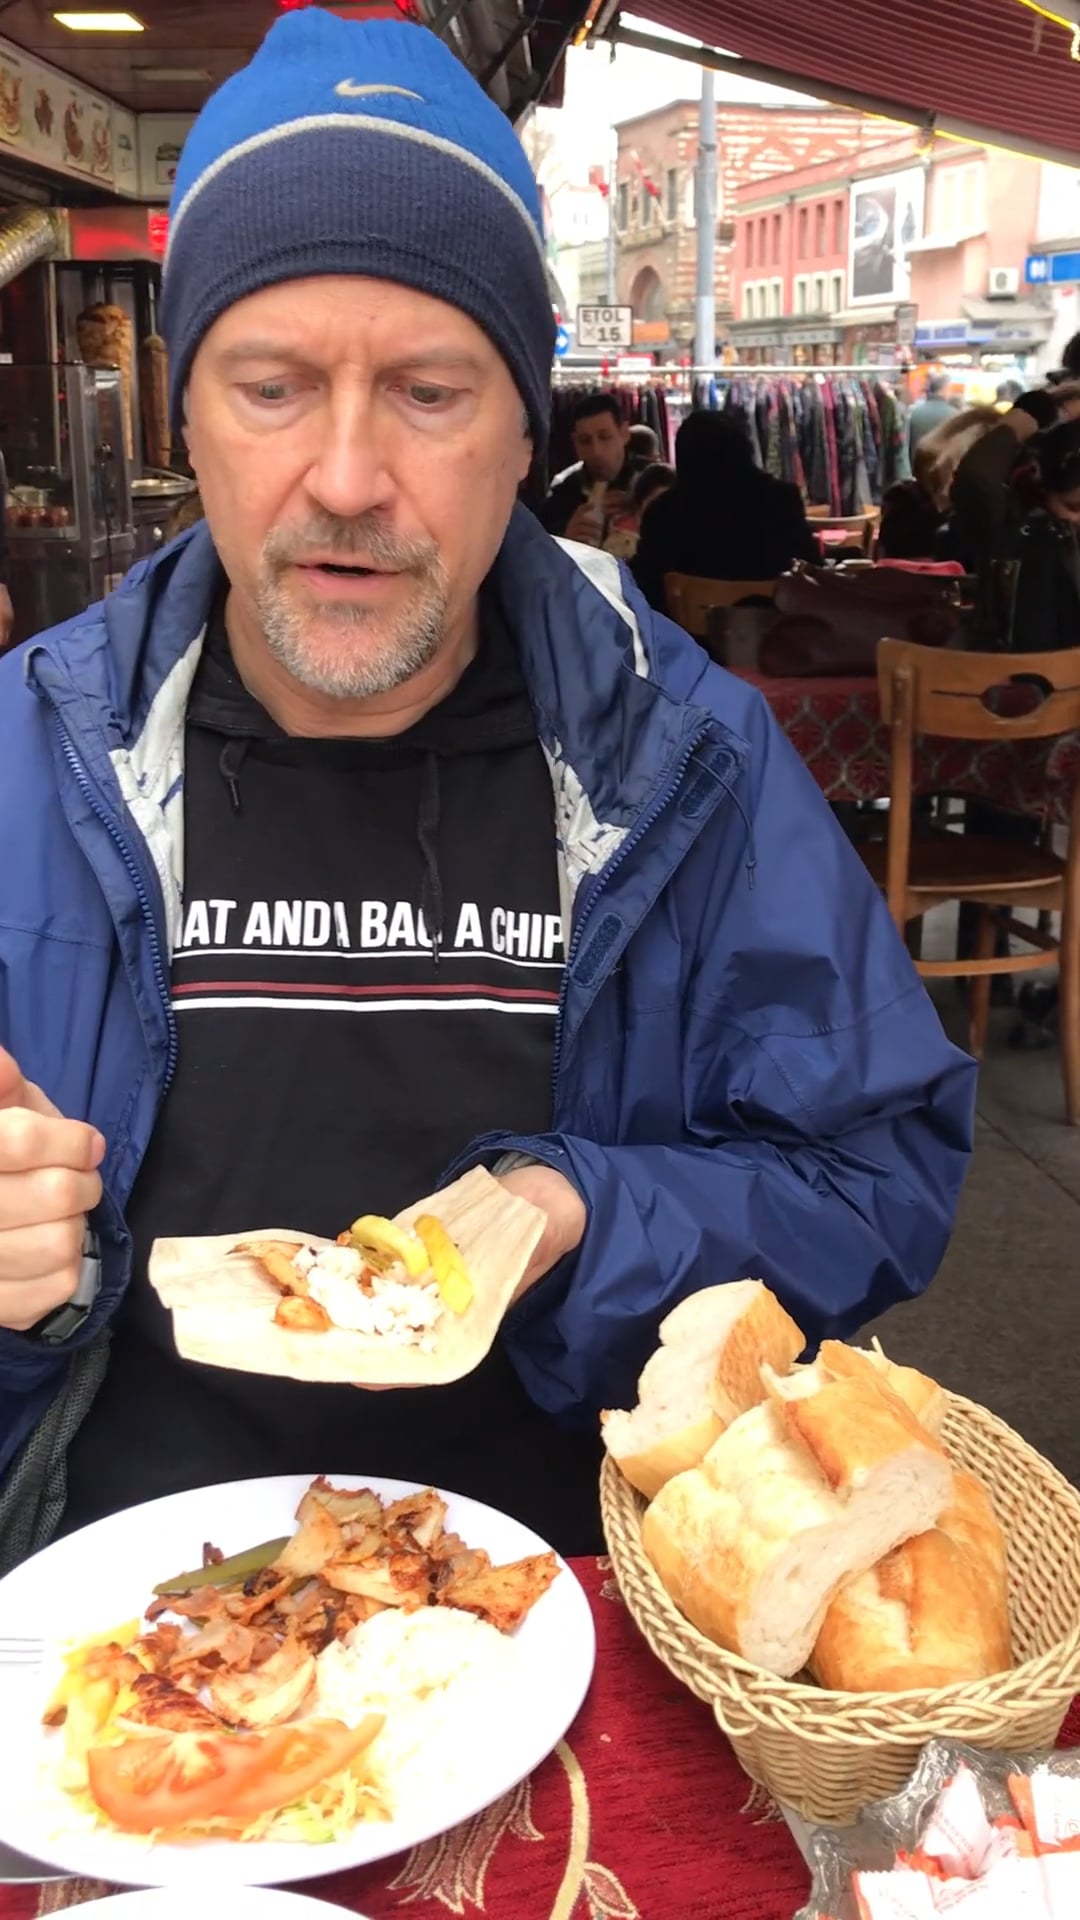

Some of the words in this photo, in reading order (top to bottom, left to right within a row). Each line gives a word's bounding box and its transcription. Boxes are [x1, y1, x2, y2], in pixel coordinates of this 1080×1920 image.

[597, 327, 621, 342] 15
[174, 900, 237, 948] AT
[242, 900, 331, 947] AND
[454, 902, 484, 948] A
